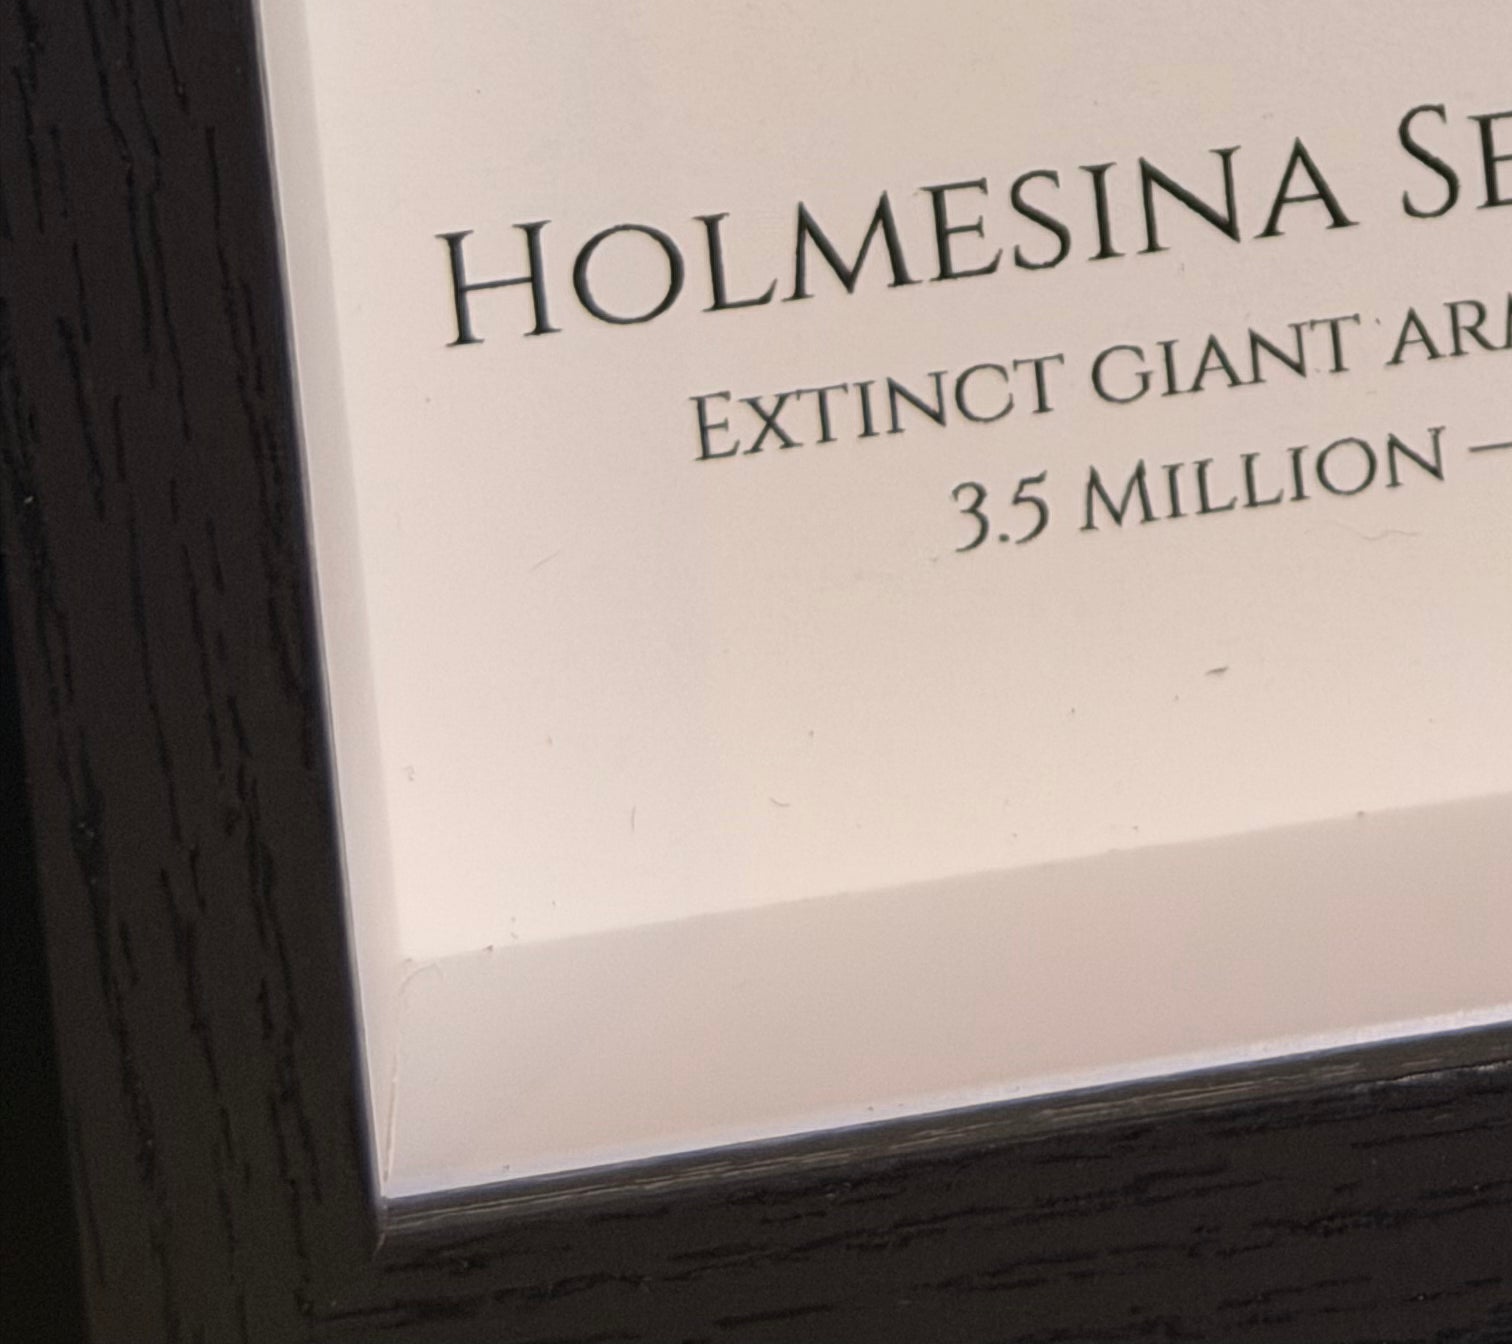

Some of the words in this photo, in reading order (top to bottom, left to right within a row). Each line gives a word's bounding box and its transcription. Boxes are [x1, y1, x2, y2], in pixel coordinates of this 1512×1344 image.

[434, 136, 1361, 349] HOLMESINA
[688, 352, 1065, 463] EXTINCT
[1090, 312, 1361, 406] GIANT
[951, 470, 1050, 554] 3.5
[1079, 425, 1446, 533] MILLION
